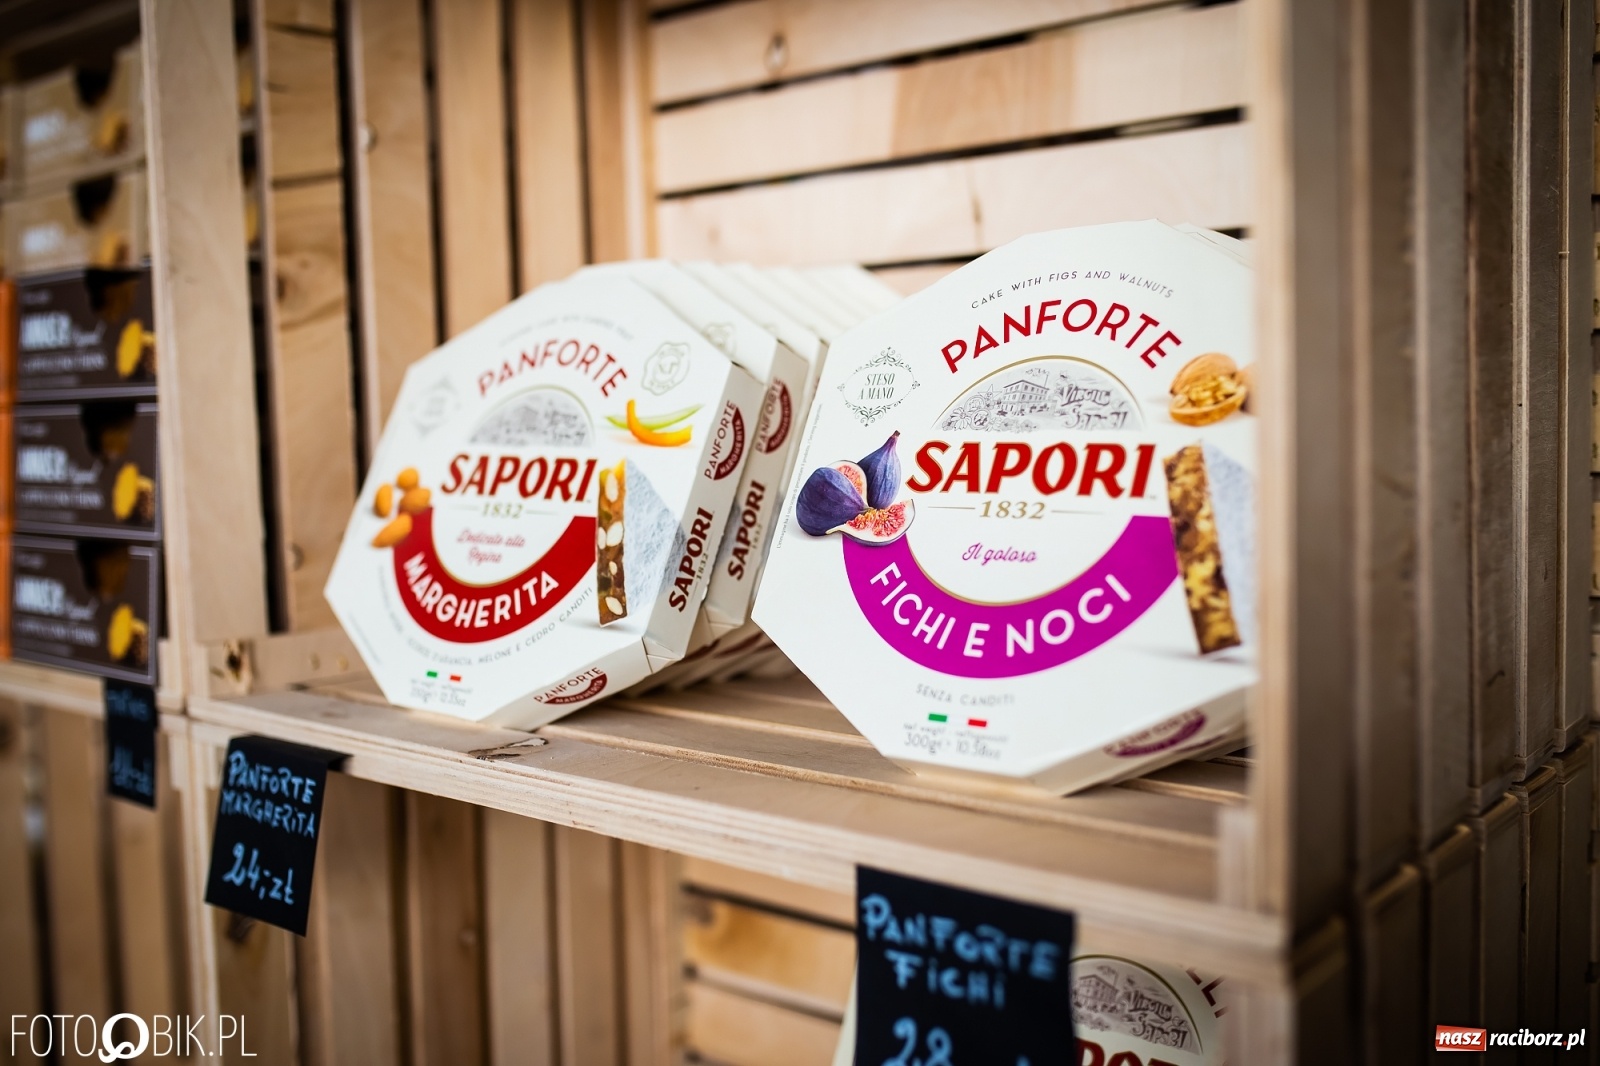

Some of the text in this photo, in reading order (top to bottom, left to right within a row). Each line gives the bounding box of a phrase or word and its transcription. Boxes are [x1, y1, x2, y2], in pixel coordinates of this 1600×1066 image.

[971, 270, 1175, 309] CAKE WITH FIGS AND WALNUTS
[941, 298, 1182, 374] PANFORTE
[477, 338, 628, 398] PANFORTE
[858, 386, 896, 400] A MANO
[865, 372, 896, 386] STESO
[704, 400, 735, 480] PANFORTE
[440, 453, 598, 502] SAPORI
[905, 440, 1157, 499] SAPORI
[482, 503, 523, 519] 1832
[727, 479, 767, 581] SAPORI
[979, 500, 1046, 520] 1832
[668, 507, 714, 613] SAPORI
[962, 542, 1037, 566] Il goloso
[403, 552, 559, 628] MARGHERITA
[525, 621, 557, 648] CEDRO
[558, 586, 594, 623] CANDITI
[869, 562, 1132, 658] FICHI E NOCI
[534, 667, 605, 703] PANFORTE
[916, 683, 952, 703] SENZA
[228, 750, 316, 804] PANFORTE
[861, 893, 1060, 981] PANFORTE
